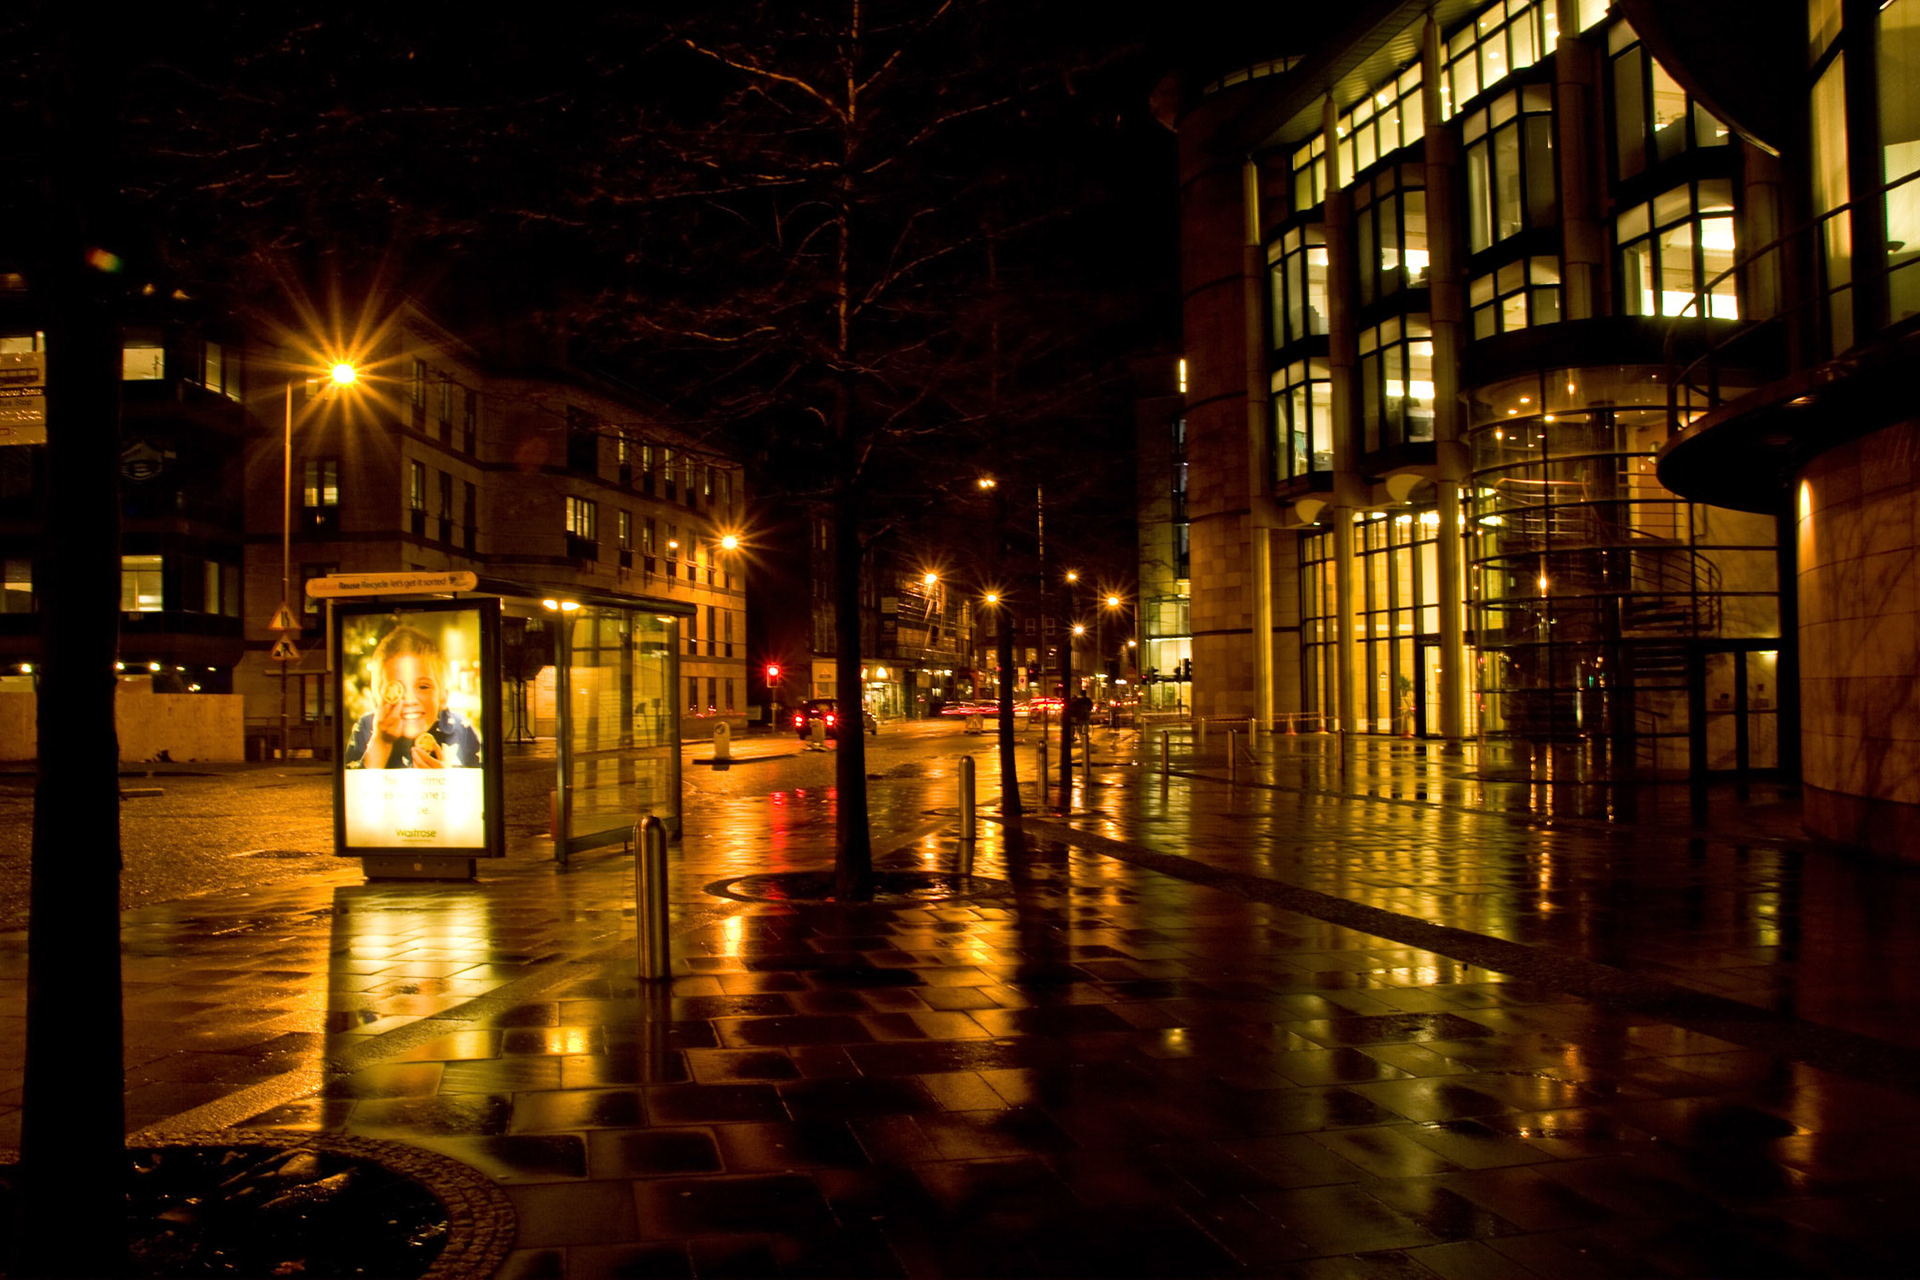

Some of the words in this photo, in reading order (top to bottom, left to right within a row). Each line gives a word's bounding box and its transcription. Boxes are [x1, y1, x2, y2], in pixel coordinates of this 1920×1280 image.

[339, 581, 360, 590] Reuse
[361, 581, 389, 591] Recycle
[405, 579, 416, 589] get
[424, 577, 446, 586] sorted
[396, 828, 437, 838] Waitrose
